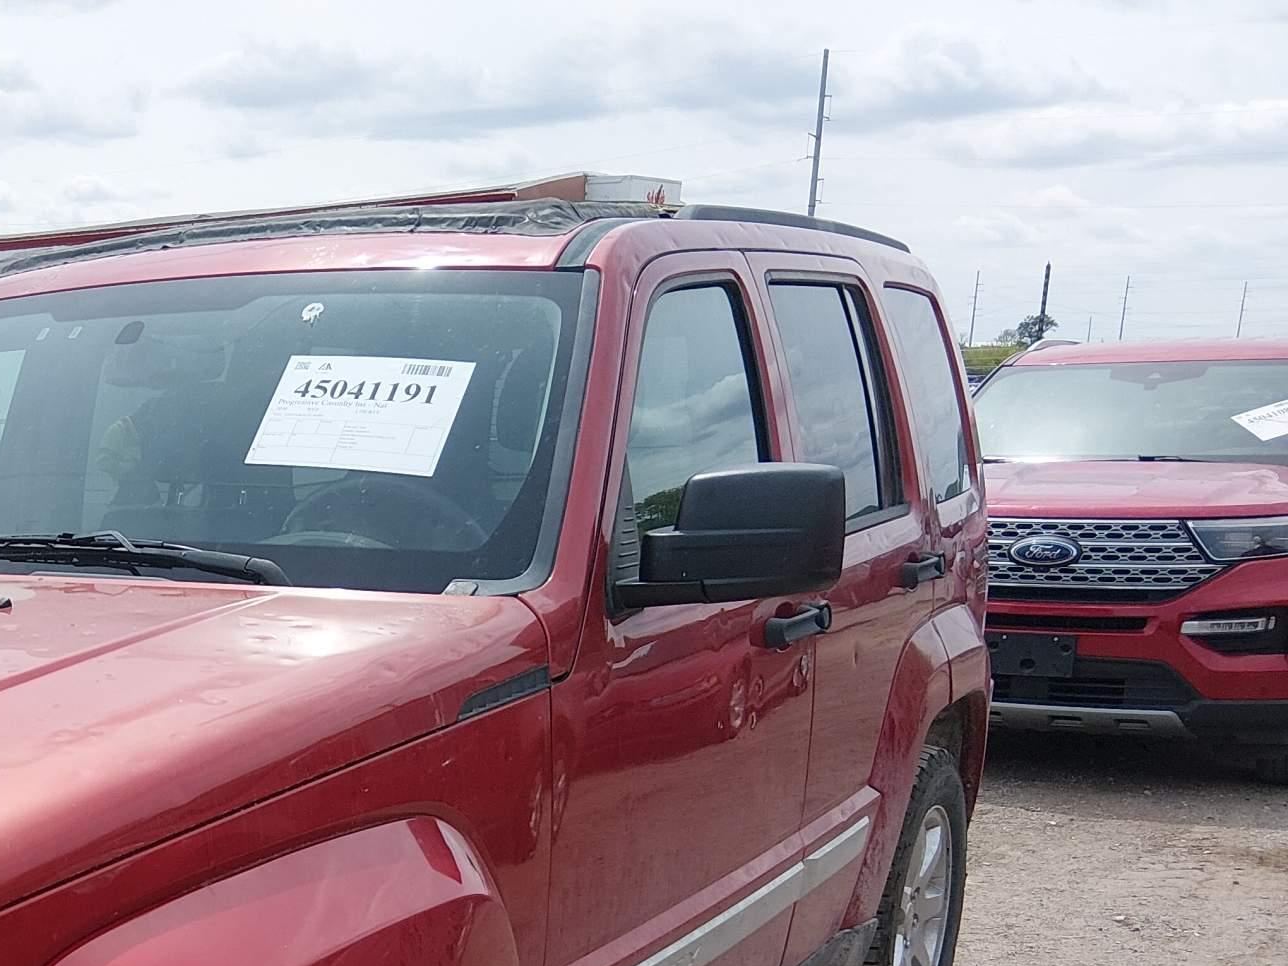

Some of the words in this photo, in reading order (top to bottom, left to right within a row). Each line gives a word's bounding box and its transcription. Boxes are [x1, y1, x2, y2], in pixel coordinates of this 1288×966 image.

[293, 379, 437, 405] 45041191
[278, 399, 320, 407] Progressive
[1025, 544, 1062, 560] Ford
